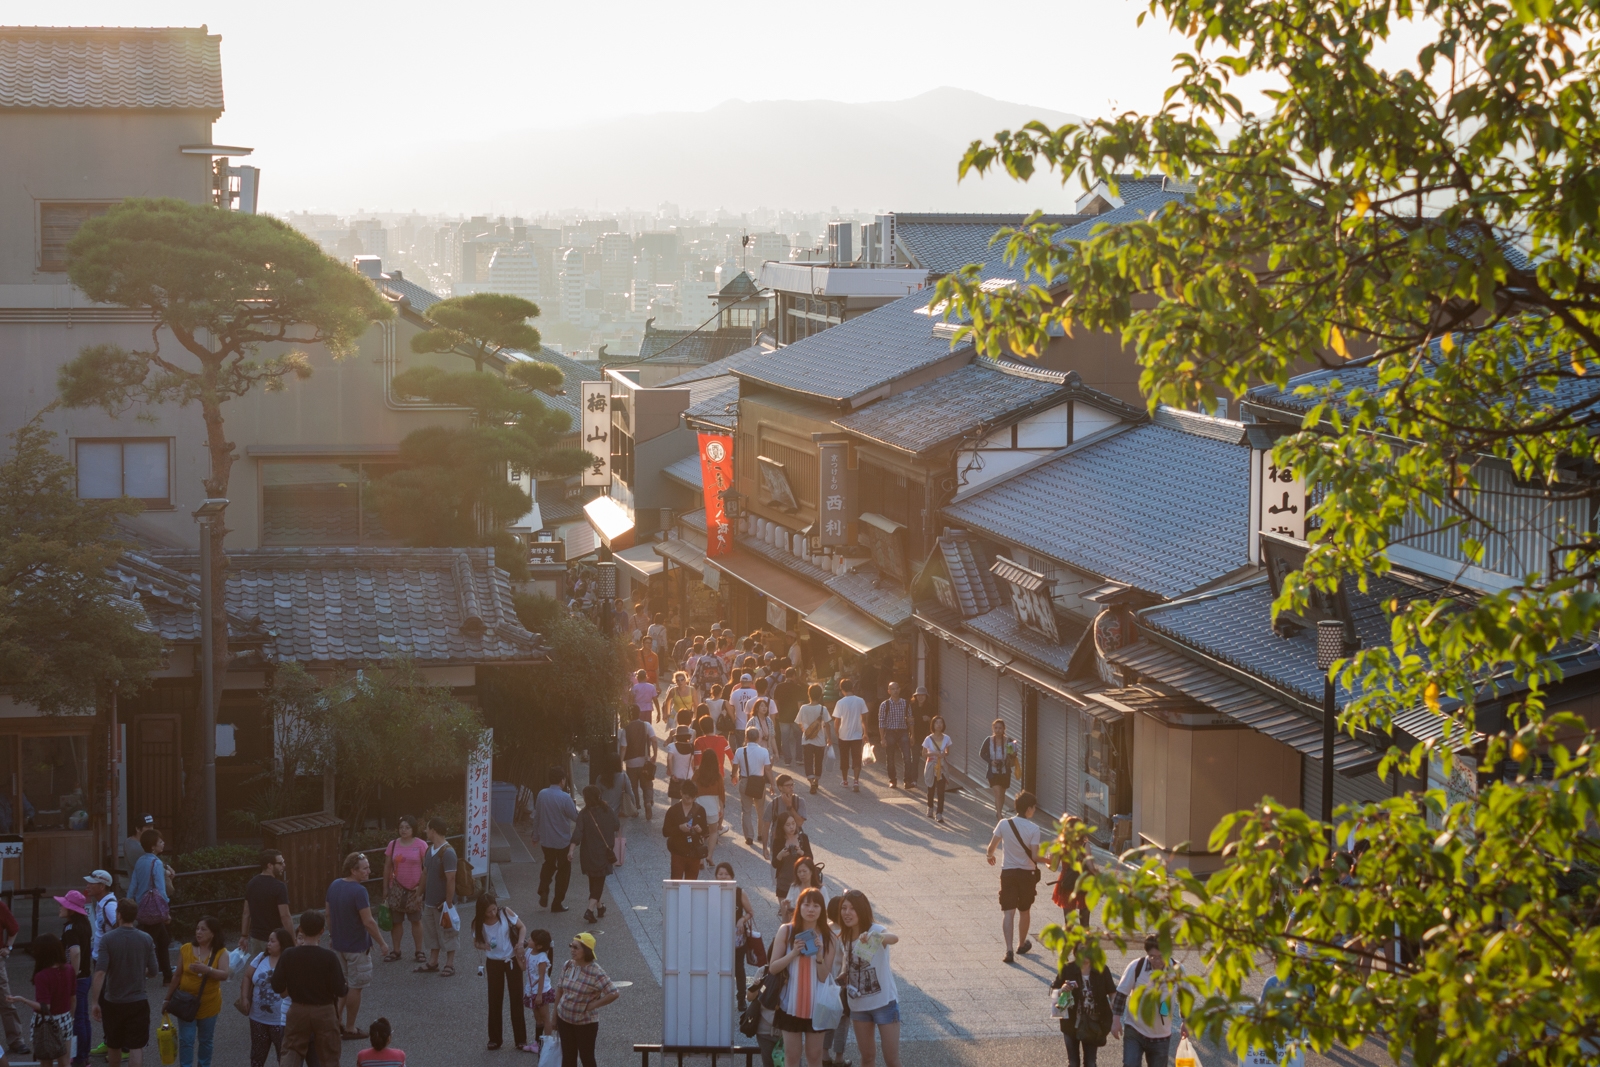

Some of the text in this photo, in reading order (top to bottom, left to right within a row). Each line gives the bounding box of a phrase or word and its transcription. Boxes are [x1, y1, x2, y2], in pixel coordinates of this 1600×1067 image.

[586, 392, 609, 477] 梅山堂
[830, 454, 839, 491] 京つけもの
[825, 494, 843, 537] 西利
